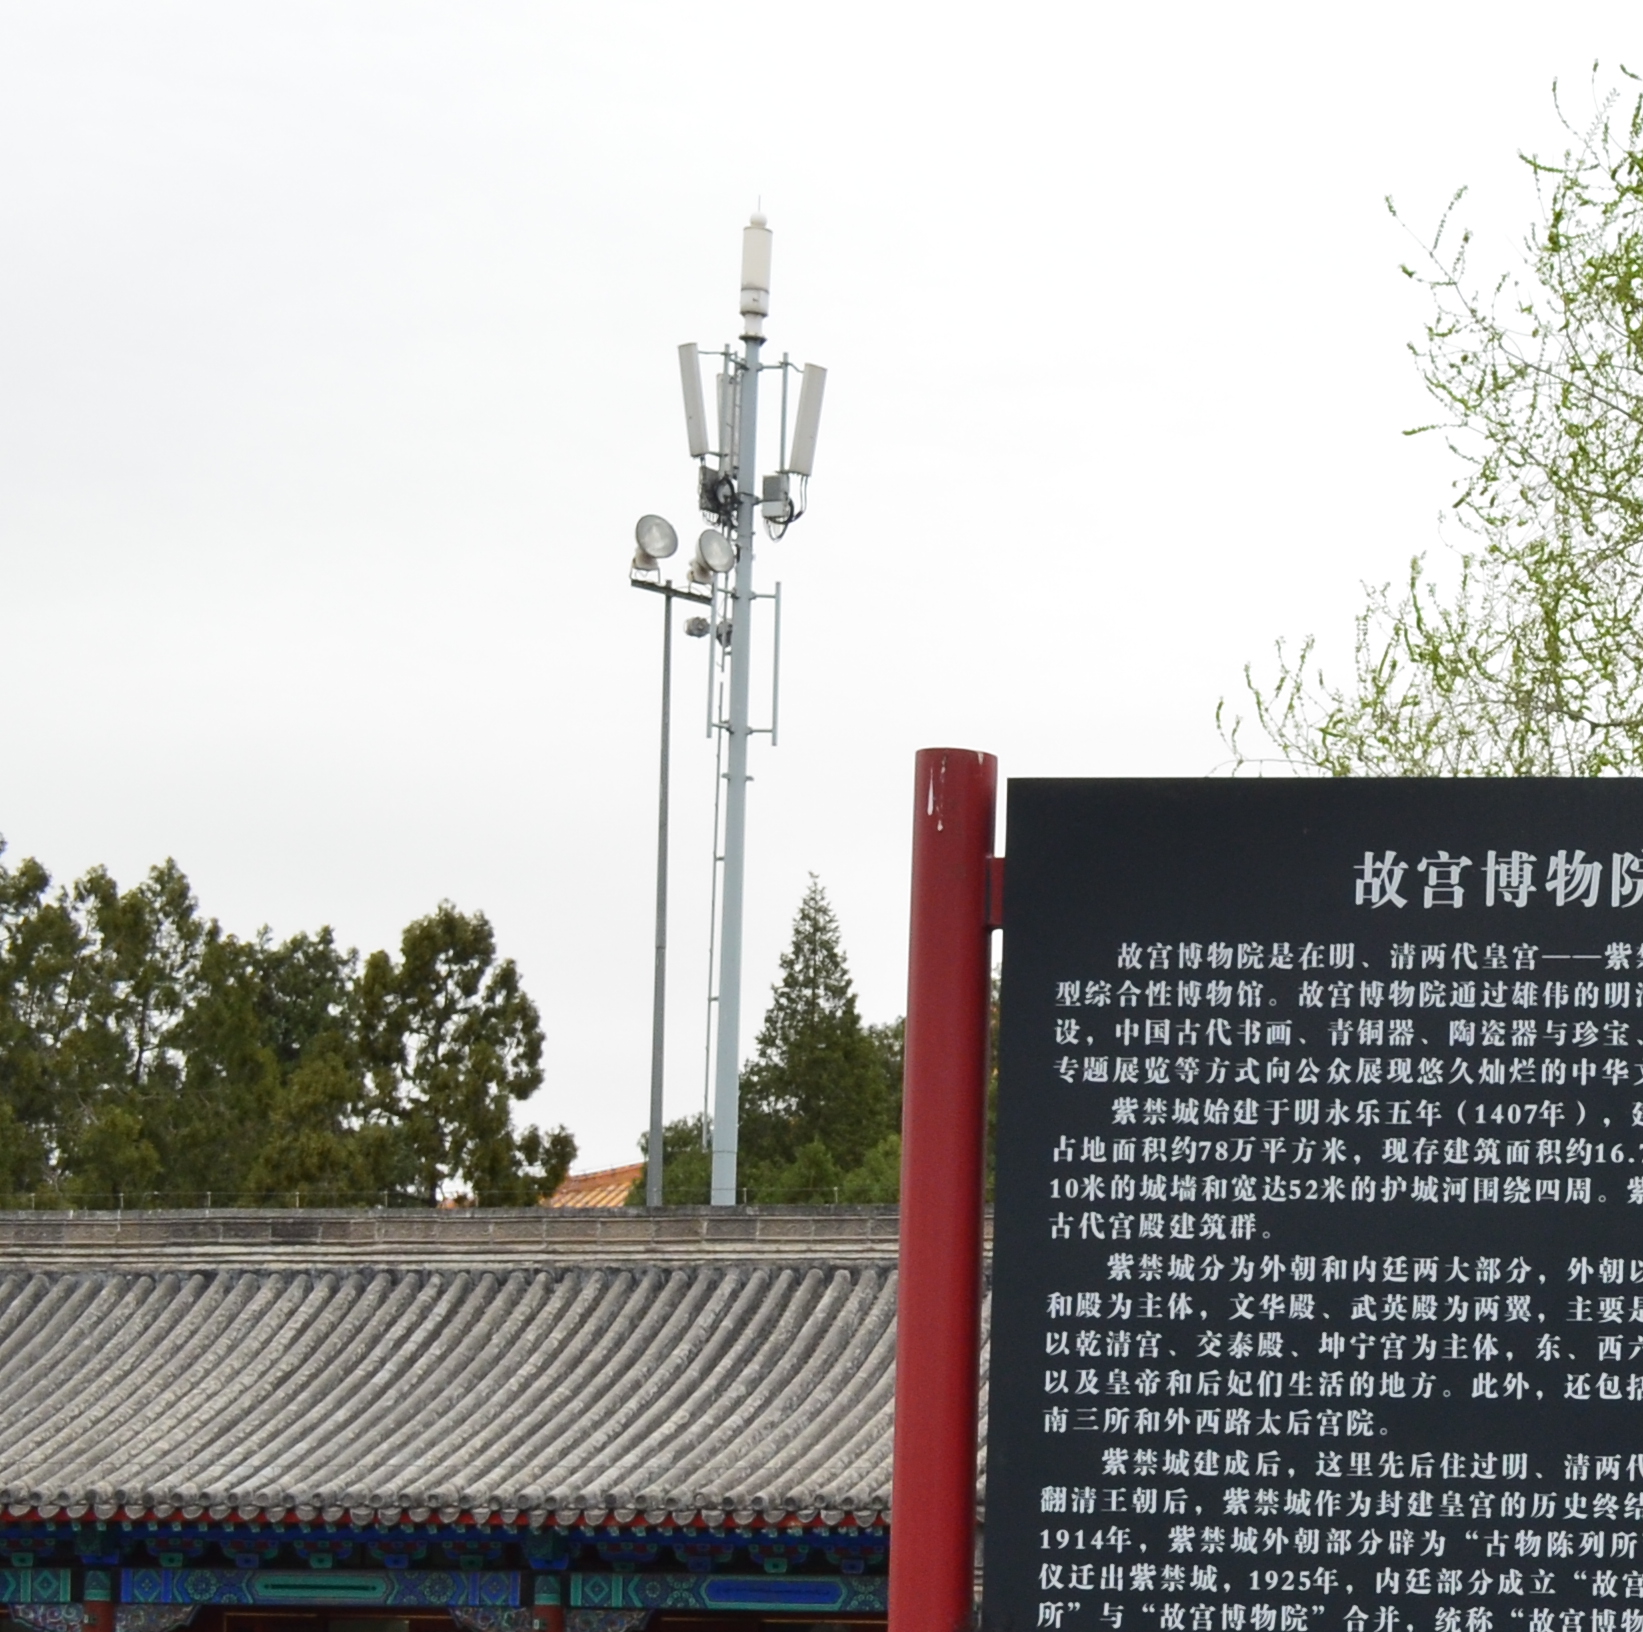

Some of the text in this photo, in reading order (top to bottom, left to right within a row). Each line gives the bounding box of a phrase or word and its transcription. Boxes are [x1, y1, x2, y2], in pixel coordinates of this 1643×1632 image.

[1049, 1210, 1271, 1241] 古代宫殿建筑群。
[1044, 1405, 1388, 1438] 南三所和外西路太后宫院。
